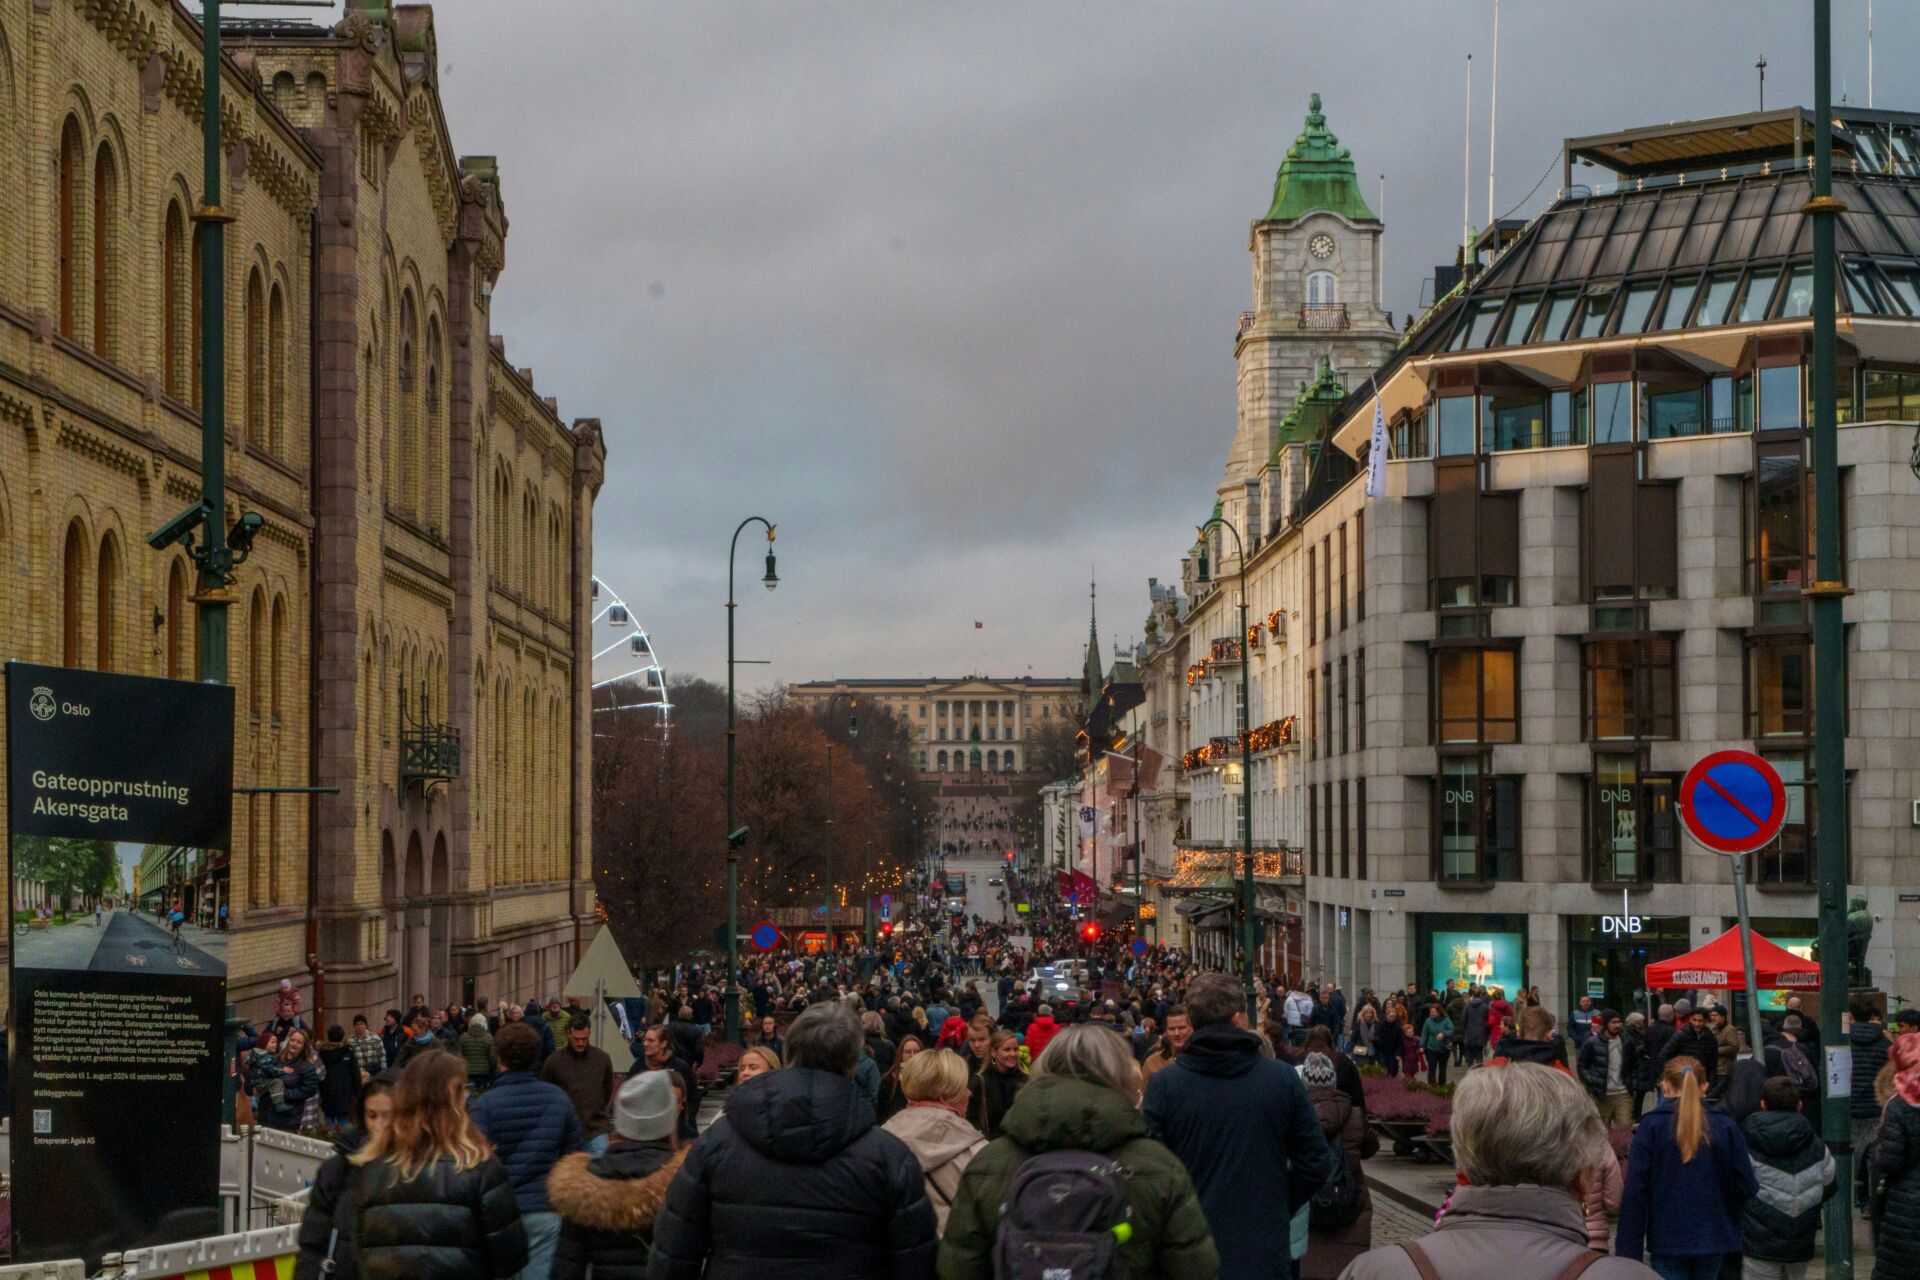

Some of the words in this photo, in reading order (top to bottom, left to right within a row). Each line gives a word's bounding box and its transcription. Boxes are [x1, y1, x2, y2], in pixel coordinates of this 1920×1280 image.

[62, 702, 91, 717] Oslo
[32, 770, 189, 805] Gateopprustning
[1446, 790, 1474, 803] DNB
[1601, 789, 1631, 803] DNB
[32, 797, 128, 823] Akersgata
[1673, 970, 1728, 985] KLASSEKAMPEN
[34, 990, 48, 998] Oslo
[50, 990, 78, 999] kommune
[120, 994, 155, 1003] oppgraderer
[156, 994, 184, 1004] Akersgata
[184, 996, 192, 1004] på
[34, 1000, 70, 1008] strekningen
[34, 1008, 88, 1017] Stortingskvartalet
[182, 1013, 200, 1021] bedre
[34, 1017, 56, 1025] forhold
[66, 1018, 88, 1027] gående
[88, 1020, 96, 1028] og
[94, 1028, 102, 1036] på
[103, 1028, 120, 1036] fortau
[89, 1037, 128, 1046] oppgradering
[177, 1040, 206, 1048] etablering
[74, 1046, 100, 1054] sandfang
[104, 1046, 136, 1054] forbindelse
[42, 1054, 72, 1062] etablering
[80, 1054, 92, 1062] nytt
[33, 1072, 78, 1081] Anleggsperiode
[93, 1073, 112, 1082] august
[136, 1074, 168, 1082] september
[34, 1089, 84, 1098] #slikbyggervioslo
